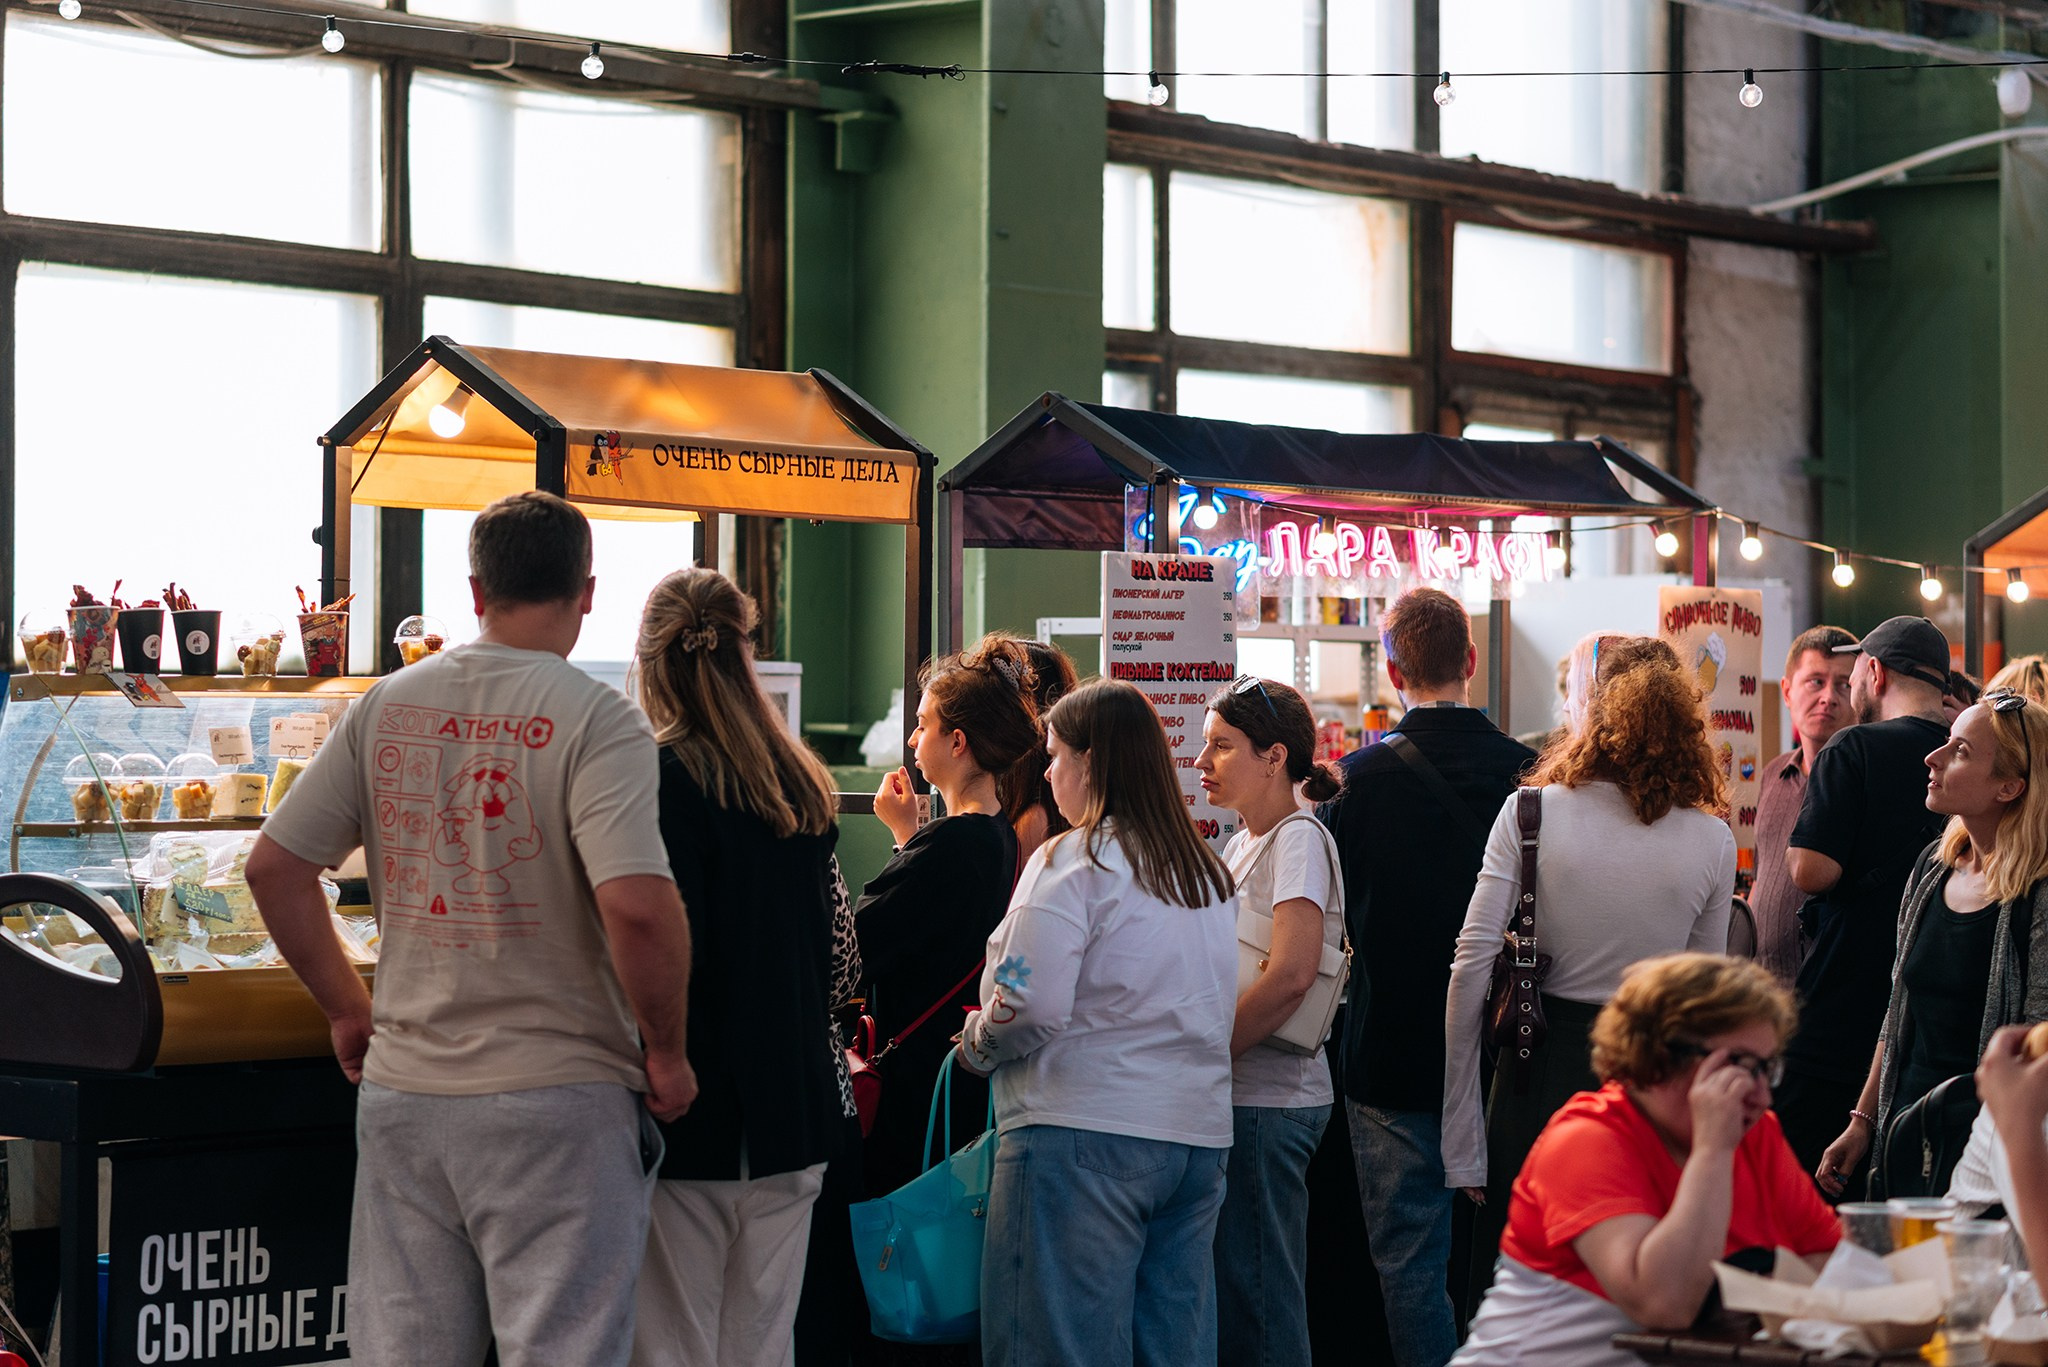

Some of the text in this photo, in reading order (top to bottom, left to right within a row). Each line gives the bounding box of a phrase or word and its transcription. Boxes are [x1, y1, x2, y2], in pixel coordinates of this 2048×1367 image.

[653, 443, 899, 483] ОЧЕНЬ СЫРНЫЕ ДЕЛА
[1131, 560, 1214, 582] НА КРАНЕ
[1112, 588, 1233, 601] ПИОНЕРСКИЙ ЛАГЕР 350
[1112, 610, 1233, 622] НЕФИЛЬТРОВАННОЕ 350
[1112, 631, 1233, 643] СИДР ЯБЛОЧНЫЙ 350
[1112, 642, 1143, 653] полусухой
[1111, 661, 1235, 682] ПИВНЫЕ КОКТЕЙЛИ
[1179, 692, 1207, 705] ПИВО
[1224, 824, 1234, 833] 550
[139, 1226, 271, 1296] ОЧЕНЬ
[137, 1284, 351, 1365] СЫРНЫЕ Д
